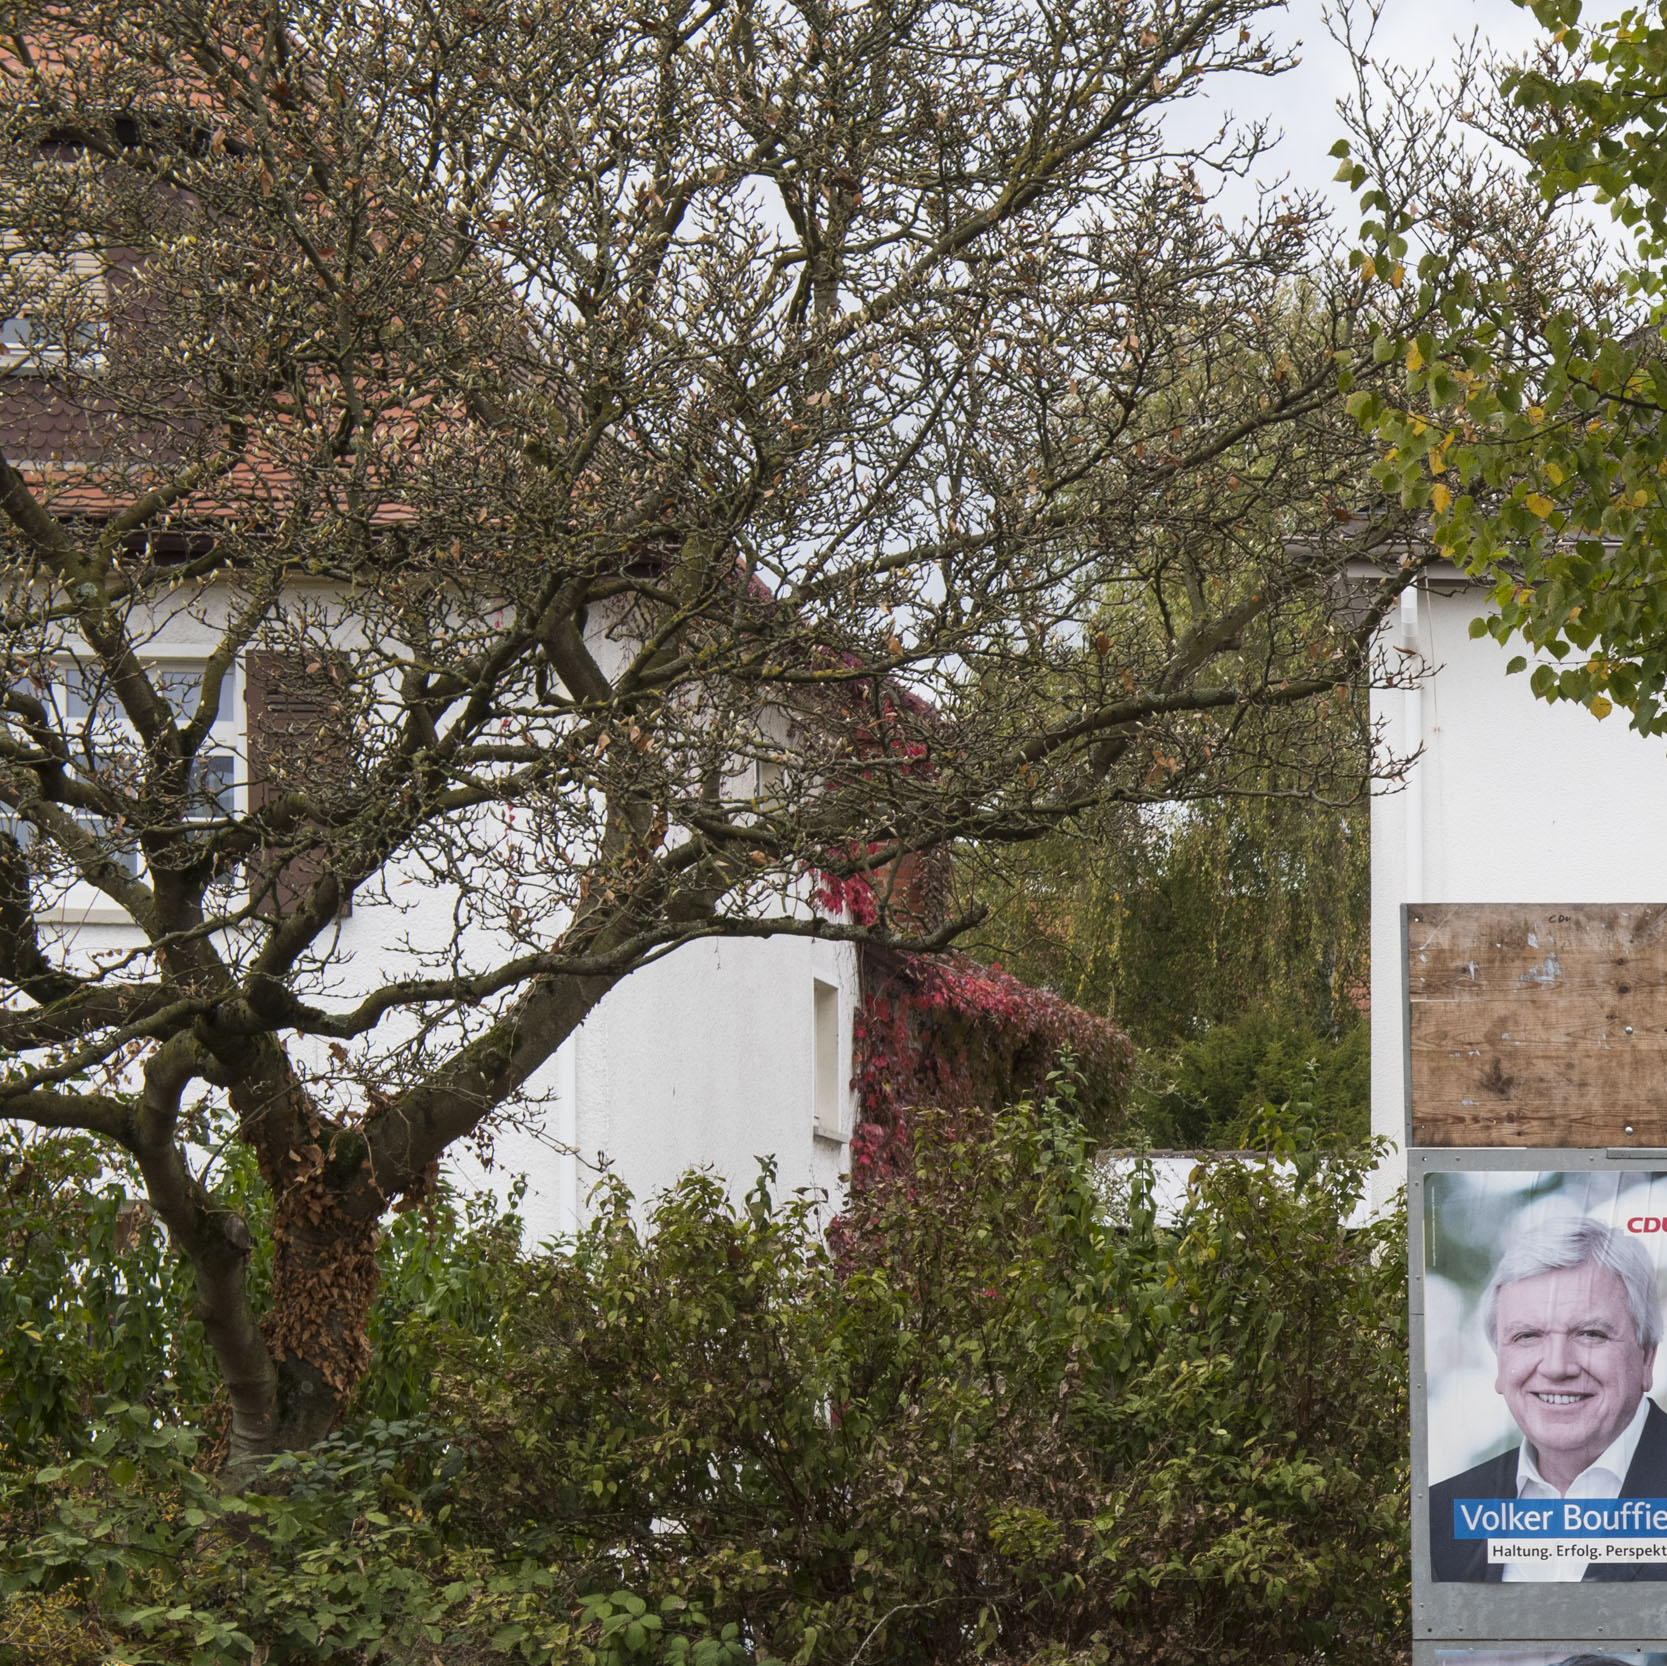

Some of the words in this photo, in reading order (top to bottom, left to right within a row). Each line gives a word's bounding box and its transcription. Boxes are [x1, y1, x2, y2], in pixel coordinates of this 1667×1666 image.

[1461, 1504, 1553, 1531] Volker
[1493, 1544, 1552, 1560] Haltung.
[1557, 1544, 1602, 1560] Erfolg.
